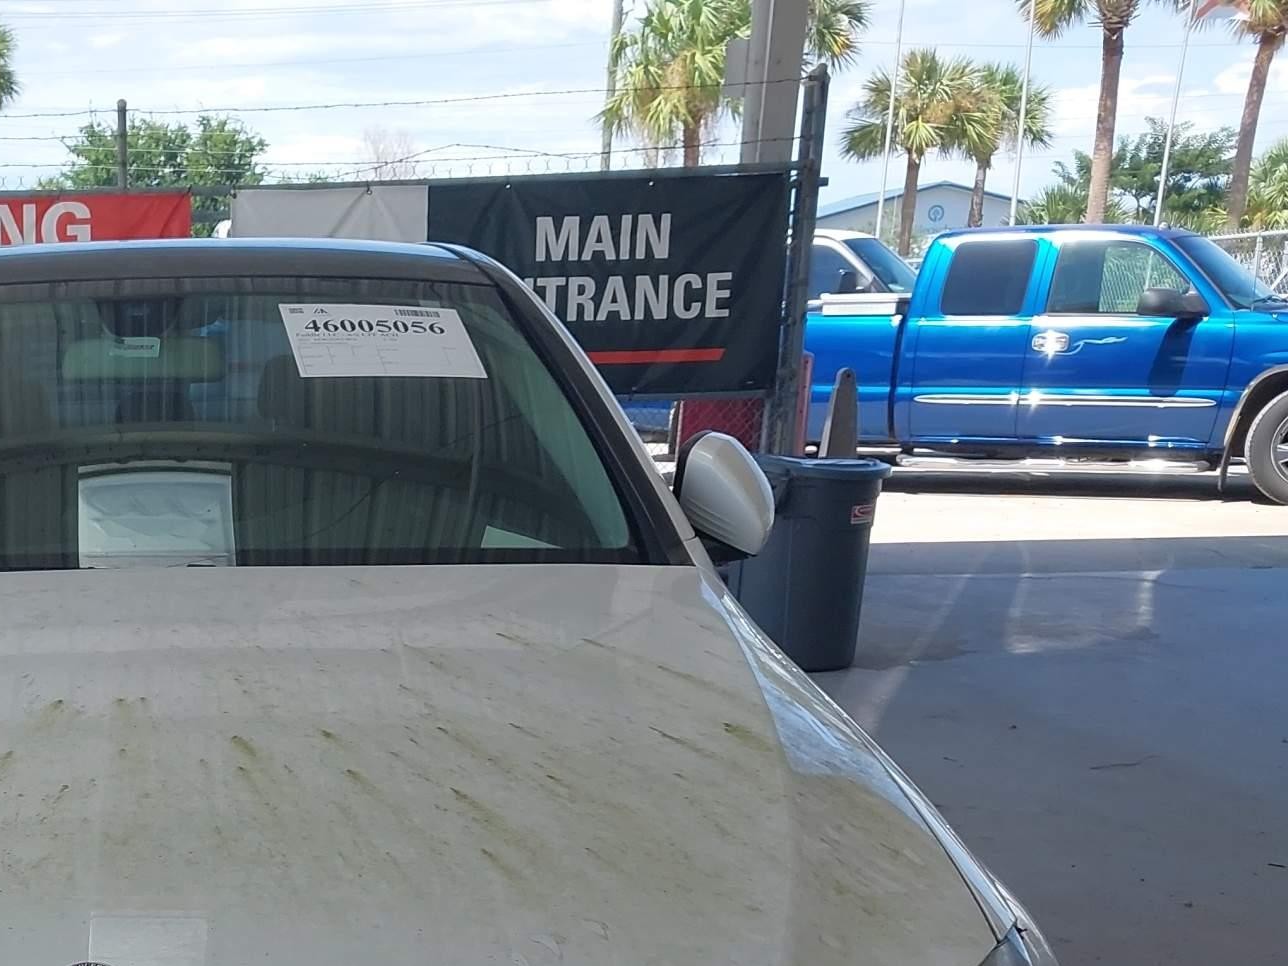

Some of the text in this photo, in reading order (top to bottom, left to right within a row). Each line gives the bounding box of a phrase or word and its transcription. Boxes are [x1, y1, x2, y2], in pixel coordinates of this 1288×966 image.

[535, 213, 672, 262] MAIN
[523, 272, 733, 322] TRANCE
[304, 319, 446, 335] 46005056
